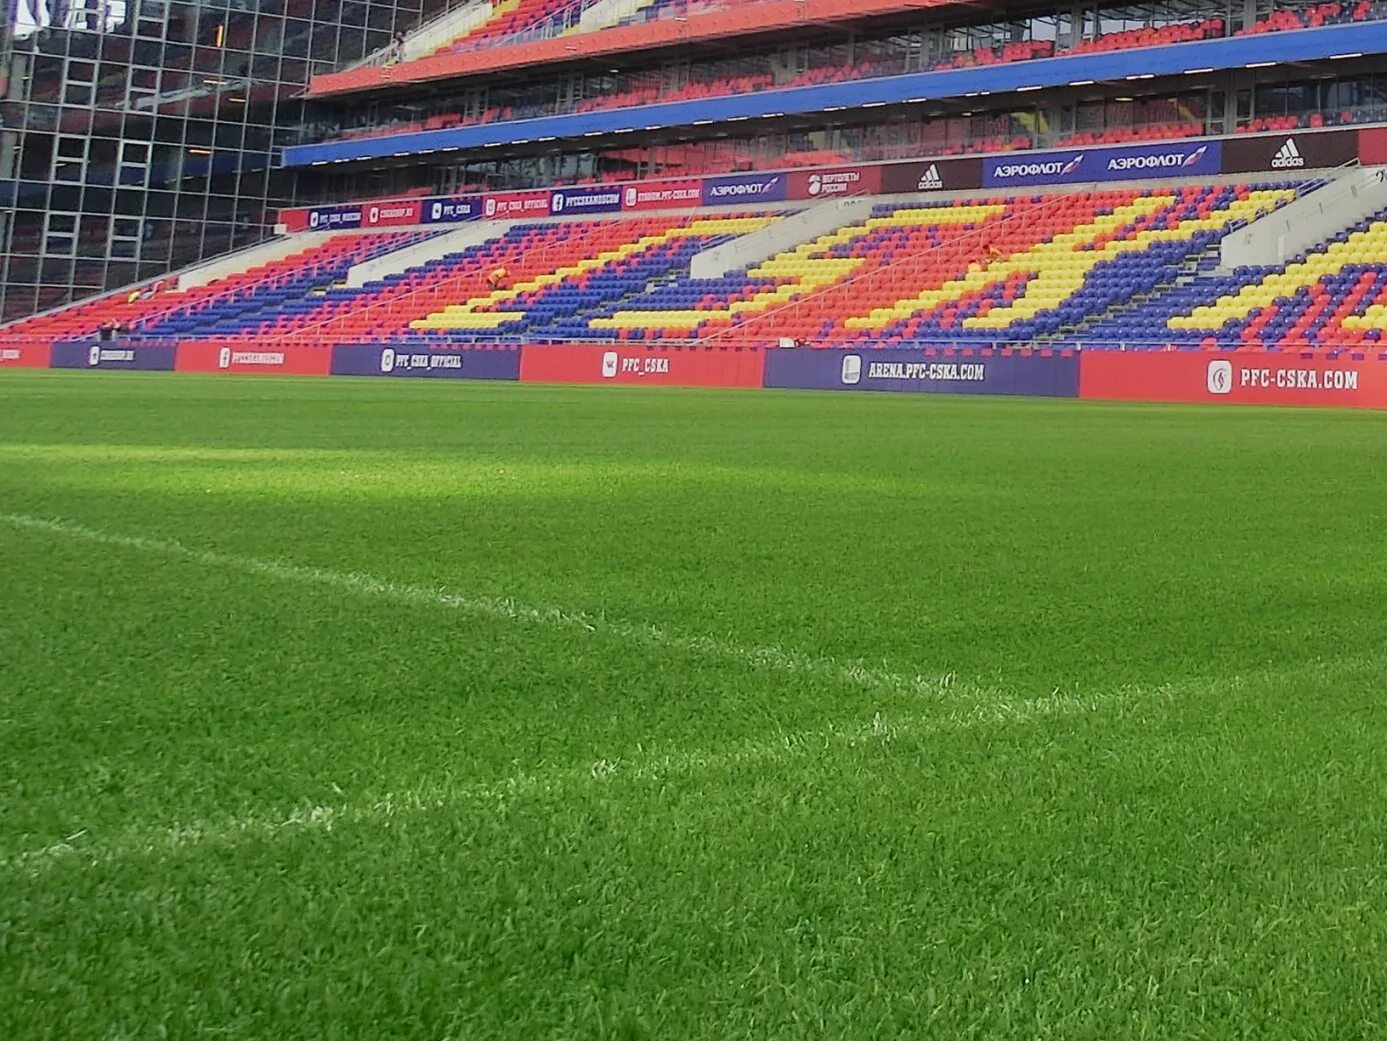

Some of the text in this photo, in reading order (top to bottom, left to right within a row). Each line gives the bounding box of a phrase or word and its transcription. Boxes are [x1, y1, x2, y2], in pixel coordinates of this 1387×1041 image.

[994, 162, 1065, 177] АЭРОФЛОТ
[1107, 153, 1186, 170] АЭРОФЛОТ
[1271, 155, 1304, 168] adidas
[710, 183, 763, 197] АЭРОФЛОТ
[622, 357, 669, 377] PFC_CSKA
[868, 362, 985, 382] ARENA.PFC-CSKA.COM
[1240, 368, 1359, 390] PFC-CSKA.COM
